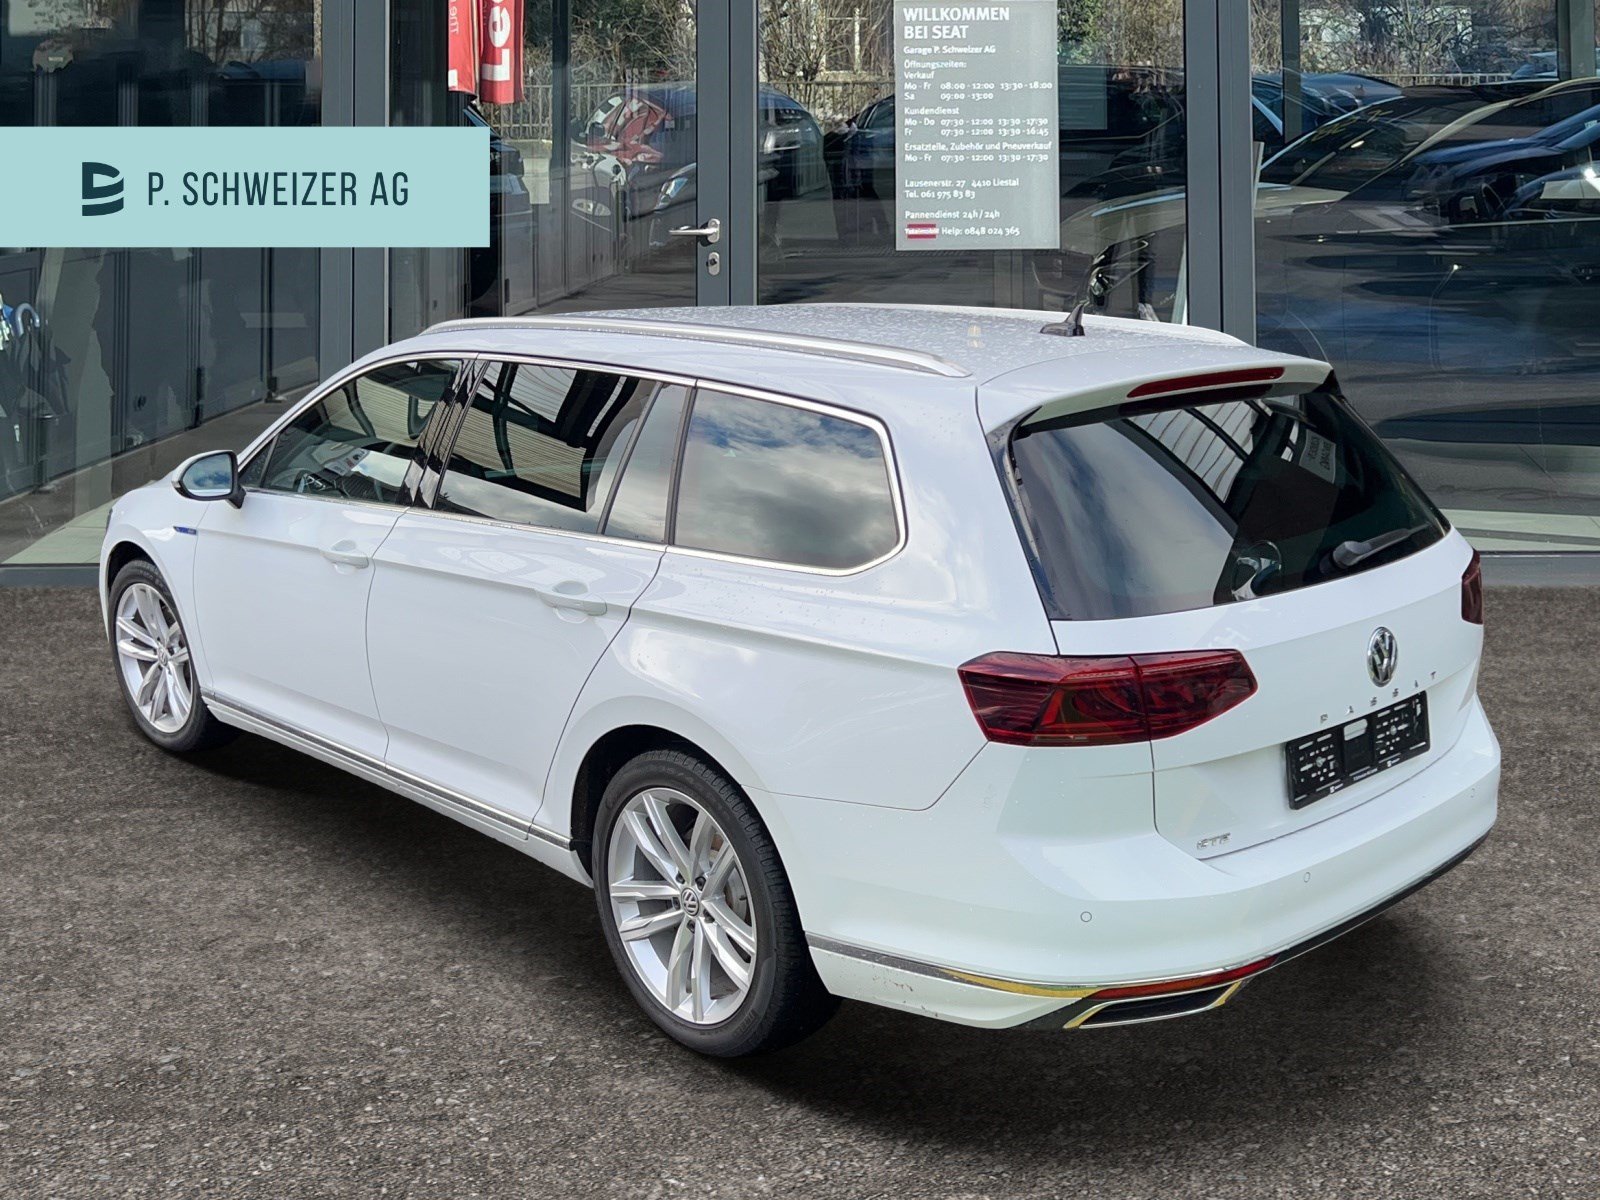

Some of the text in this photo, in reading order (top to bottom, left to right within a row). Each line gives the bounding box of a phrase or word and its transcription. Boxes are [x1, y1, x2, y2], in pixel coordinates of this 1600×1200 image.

[903, 7, 1010, 21] WILLKOMMEN
[904, 25, 969, 39] BEI SEAT
[482, 0, 511, 81] Le
[903, 45, 996, 55] Garage P. Schweizer AG
[903, 71, 935, 79] Verkauf
[904, 82, 917, 90] Mo
[940, 81, 966, 90] 08:00
[972, 82, 995, 90] 12:00
[1000, 82, 1024, 91] 13:30
[1029, 80, 1053, 89] 18:00
[904, 92, 915, 100] Sa
[940, 92, 965, 101] 09:00
[971, 92, 994, 101] 13:00
[904, 106, 960, 115] Kundendienst
[904, 118, 918, 126] Mo
[923, 118, 935, 126] Do
[940, 118, 964, 127] 07:30
[970, 118, 994, 126] 12:00
[998, 118, 1021, 127] 13:30
[1026, 118, 1049, 127] 17:30
[904, 128, 912, 136] Fr
[940, 129, 964, 137] 07:30
[971, 128, 994, 136] 12:00
[998, 128, 1021, 137] 13:30
[1026, 127, 1049, 137] 16:45
[904, 141, 1052, 152] Ersatzteile, Zubehör und Pneuverkauf
[904, 154, 918, 162] Mo
[924, 154, 932, 162] Fr
[940, 154, 965, 163] 07:30
[998, 154, 1021, 162] 13:30
[1026, 154, 1049, 162] 17:30
[904, 178, 1019, 188] Lausenerstr. 27 4410 Liestal
[904, 189, 976, 200] Tel. 061 975 83 83
[904, 210, 960, 219] Pannendienst
[962, 210, 978, 220] 24h
[984, 209, 1000, 219] 24h
[941, 227, 962, 236] Help:
[964, 226, 986, 236] 0848
[987, 227, 1004, 236] 024
[1005, 226, 1021, 236] 365
